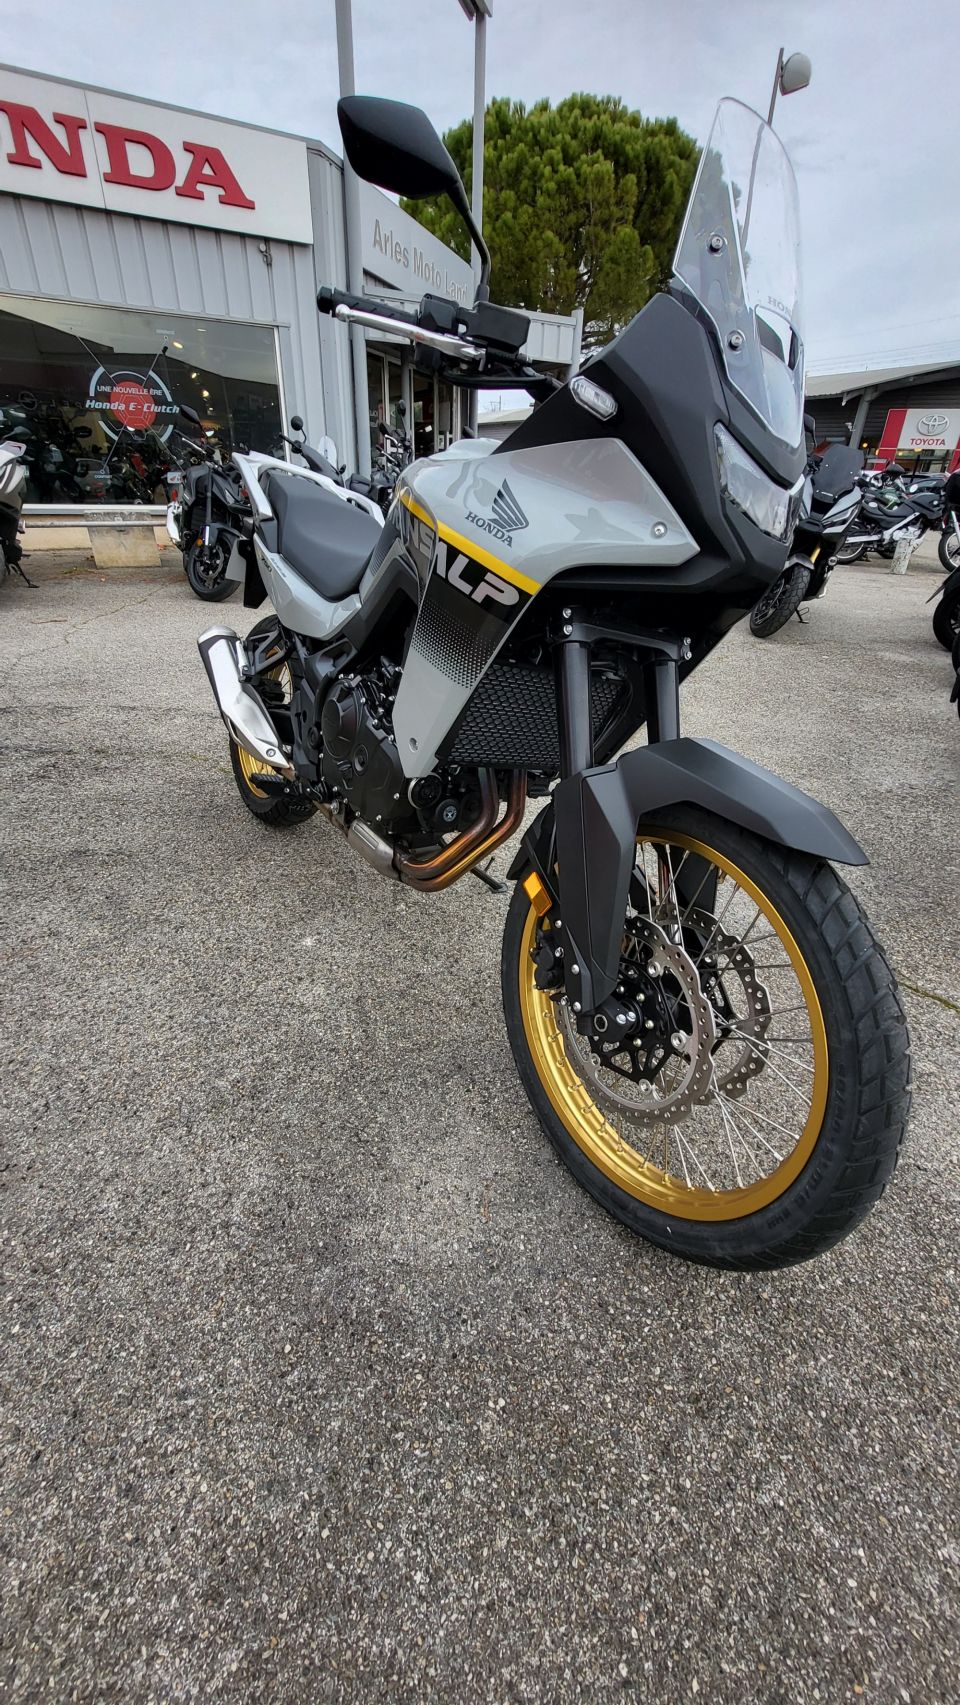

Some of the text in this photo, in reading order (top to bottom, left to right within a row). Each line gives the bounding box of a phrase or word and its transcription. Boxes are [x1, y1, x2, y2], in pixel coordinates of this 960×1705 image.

[0, 100, 255, 210] NDA
[373, 218, 410, 269] Arles
[413, 247, 442, 289] Moto
[97, 385, 112, 393] UNE
[113, 386, 149, 395] NOUVELLE
[85, 399, 126, 410] Honda
[910, 438, 946, 446] TOYOTA
[464, 511, 513, 548] HONDA
